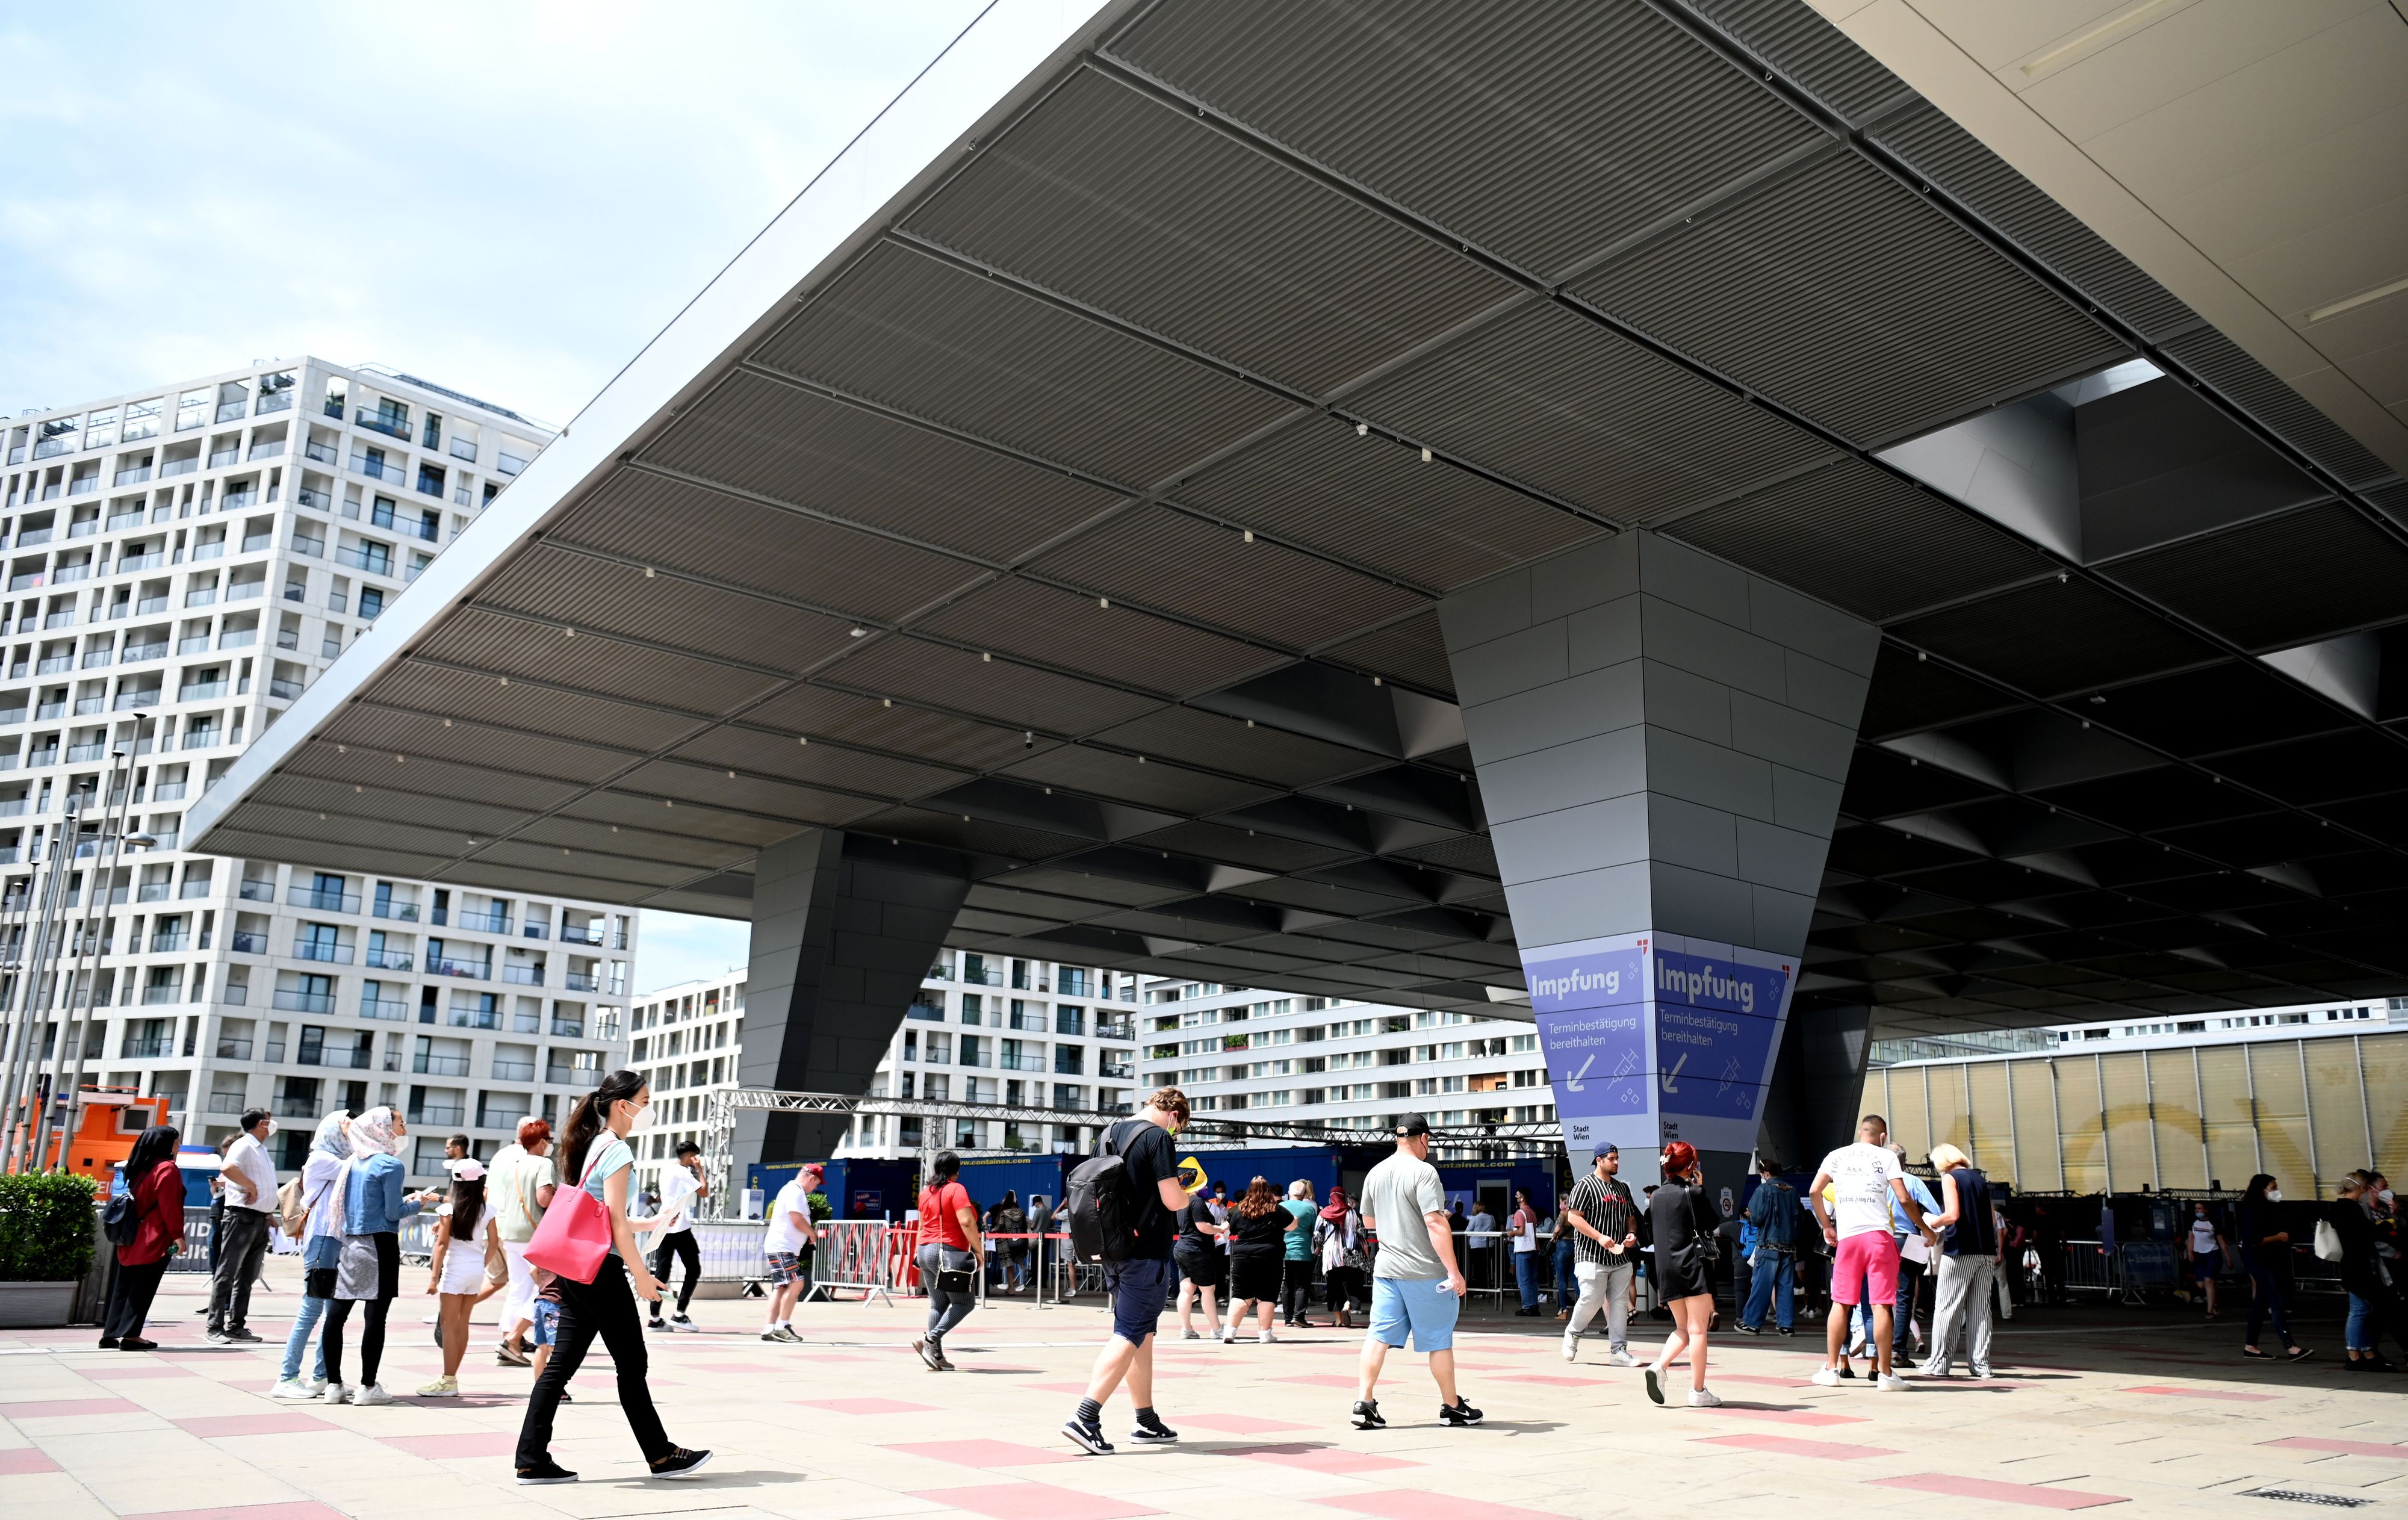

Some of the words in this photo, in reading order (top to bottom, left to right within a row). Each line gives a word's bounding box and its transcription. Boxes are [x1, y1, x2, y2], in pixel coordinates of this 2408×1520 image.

[1532, 968, 1619, 1000] Impfung
[1658, 958, 1754, 1013] Impfung
[1549, 1016, 1636, 1034] Terminbestätigung
[1660, 1009, 1738, 1035] Terminbestätigung
[1550, 1034, 1606, 1049] bereithalten
[1662, 1028, 1713, 1046] bereithalten
[1573, 1124, 1589, 1133] Stadt
[1663, 1121, 1678, 1131] Stadt
[1663, 1130, 1678, 1140] Wien
